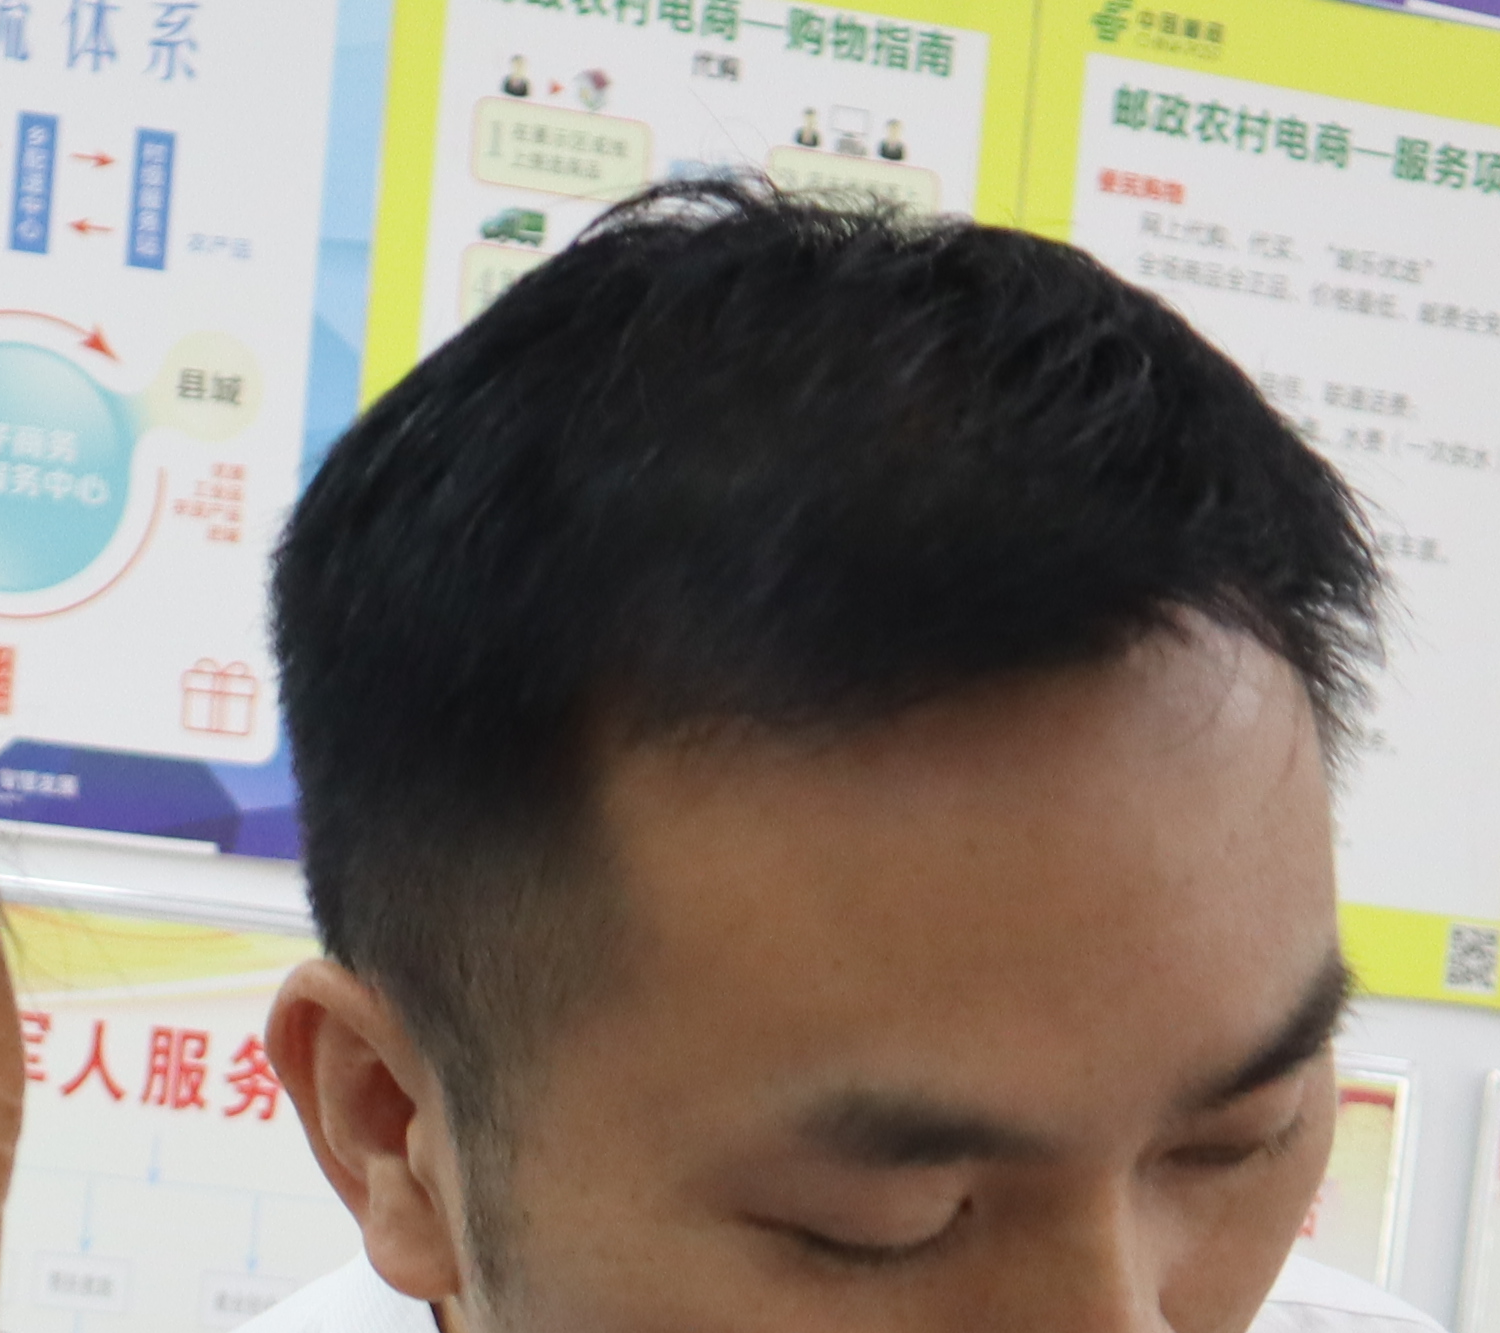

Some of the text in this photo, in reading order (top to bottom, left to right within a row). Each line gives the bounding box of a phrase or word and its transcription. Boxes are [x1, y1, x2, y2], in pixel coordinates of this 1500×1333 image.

[480, 0, 956, 79] 农村电商—购物指南
[175, 367, 243, 406] 县城
